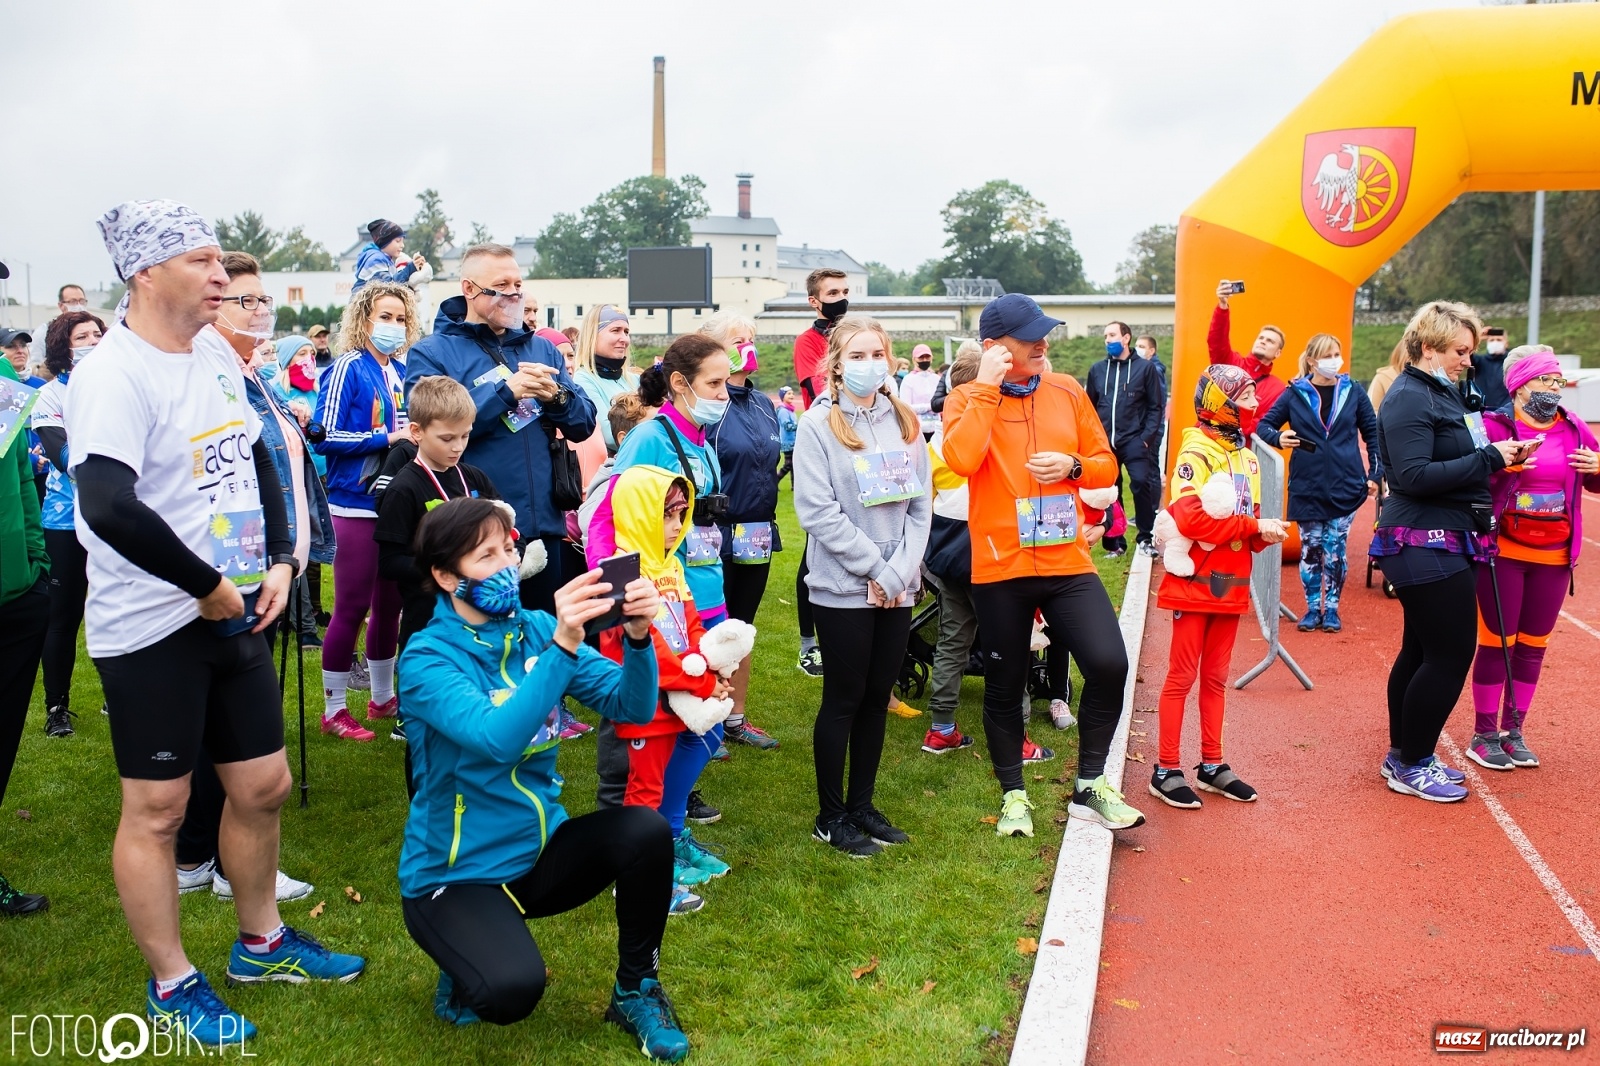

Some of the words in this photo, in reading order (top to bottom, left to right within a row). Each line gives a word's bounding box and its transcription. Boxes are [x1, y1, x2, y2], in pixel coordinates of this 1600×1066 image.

[8, 391, 30, 414] 322
[507, 410, 520, 424] 45
[897, 482, 915, 493] 117
[1058, 527, 1074, 538] 225
